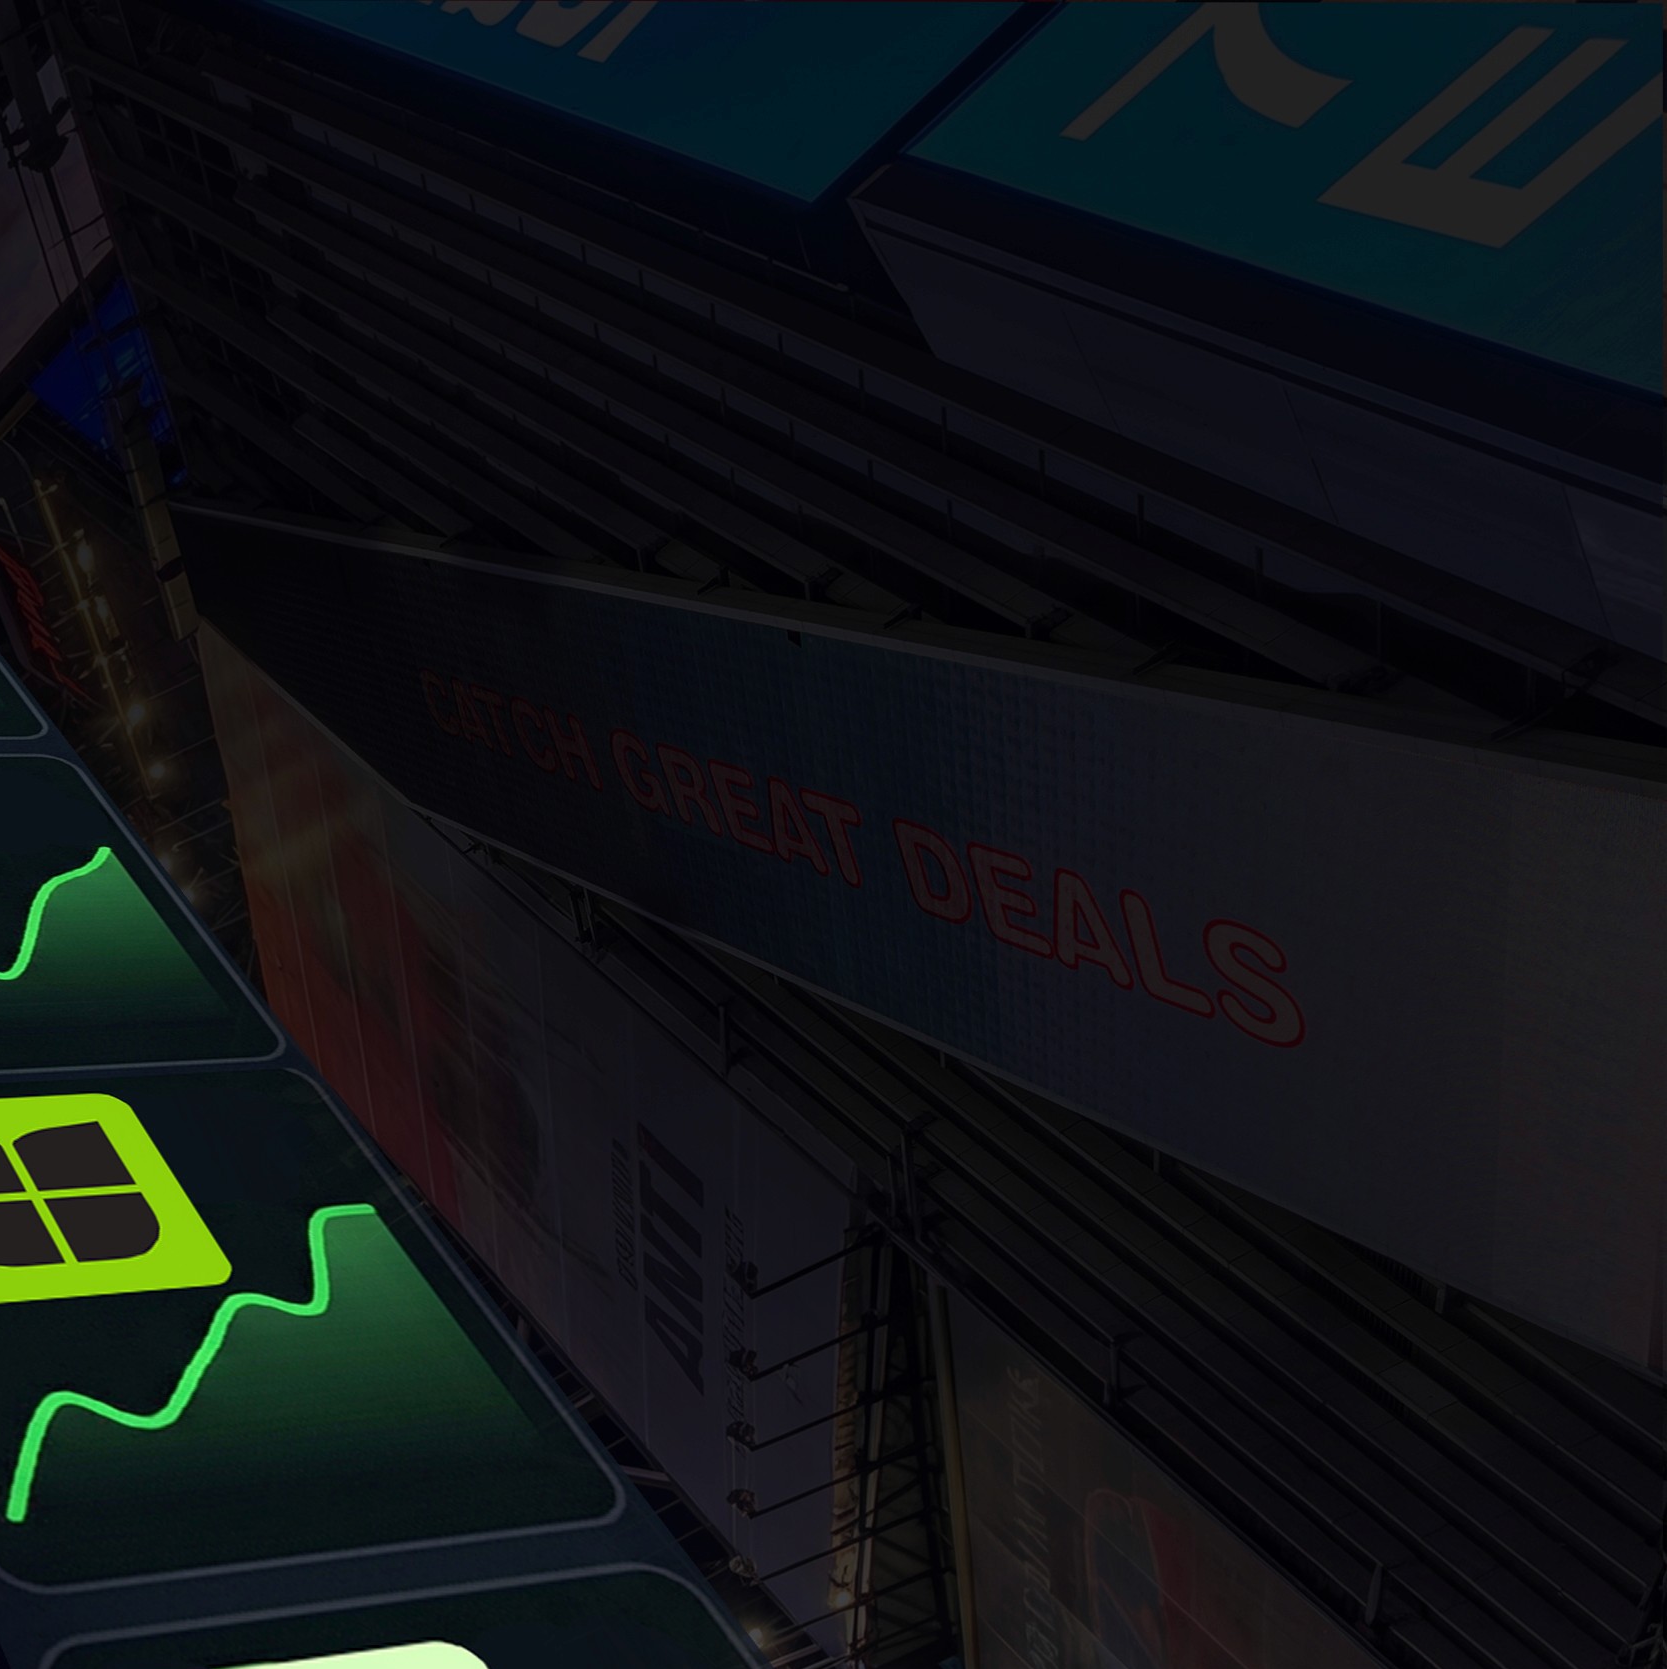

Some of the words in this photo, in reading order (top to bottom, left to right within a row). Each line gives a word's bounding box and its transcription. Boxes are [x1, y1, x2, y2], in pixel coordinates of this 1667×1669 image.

[418, 668, 603, 792] CATCH
[610, 728, 862, 888] GREAT
[892, 818, 1305, 1048] DEALS
